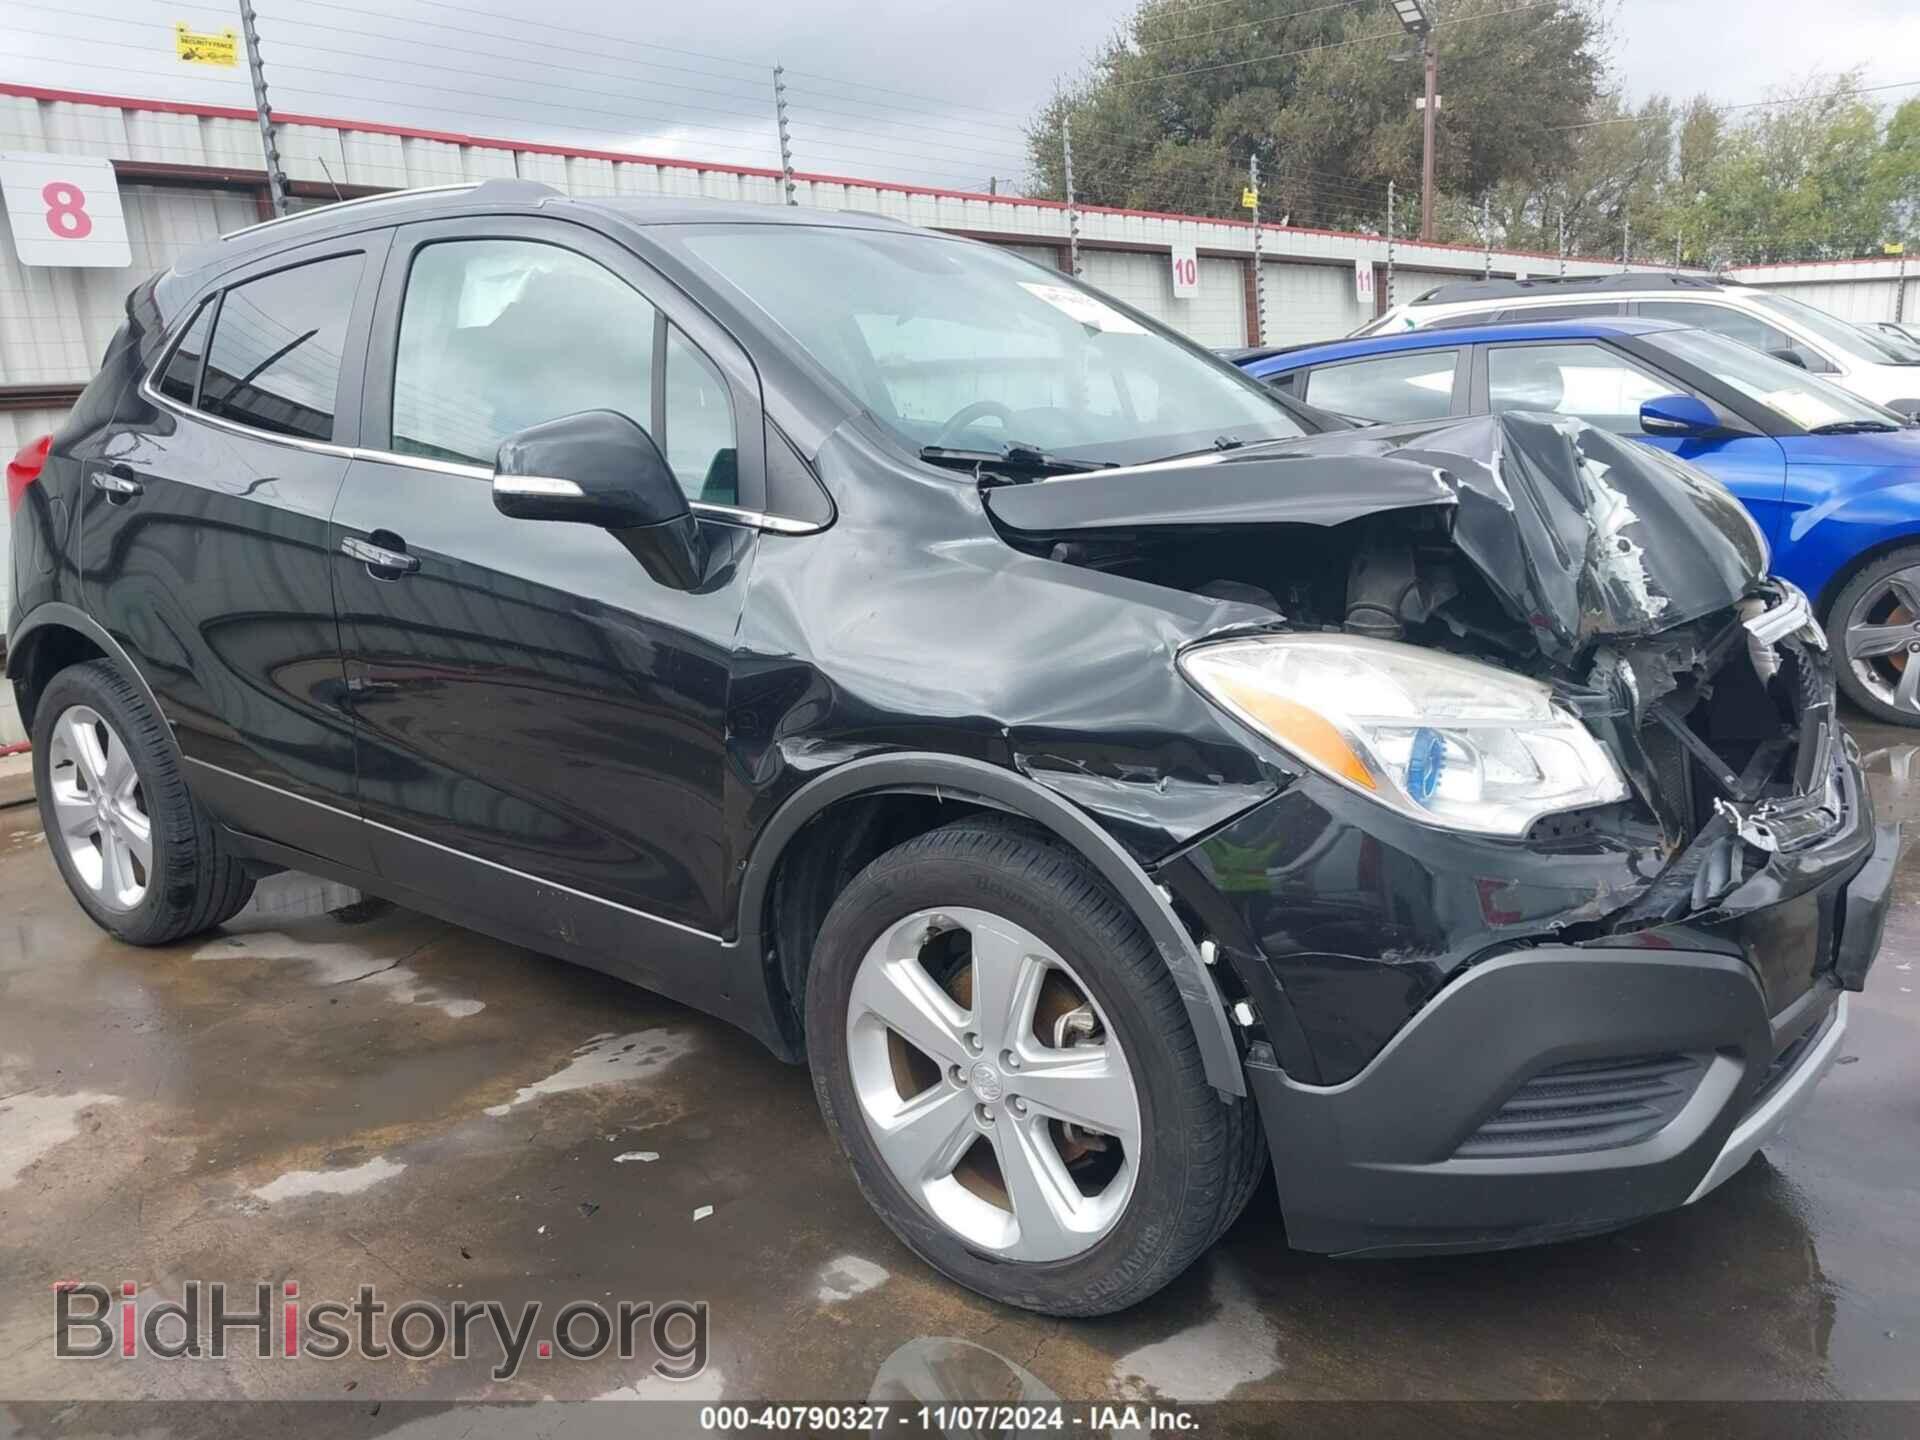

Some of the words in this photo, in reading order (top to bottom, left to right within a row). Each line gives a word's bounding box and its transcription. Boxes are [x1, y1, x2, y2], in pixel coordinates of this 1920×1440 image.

[180, 38, 212, 47] SECURITY
[42, 181, 92, 239] 8
[1175, 258, 1195, 285] 10
[1358, 270, 1371, 291] 11
